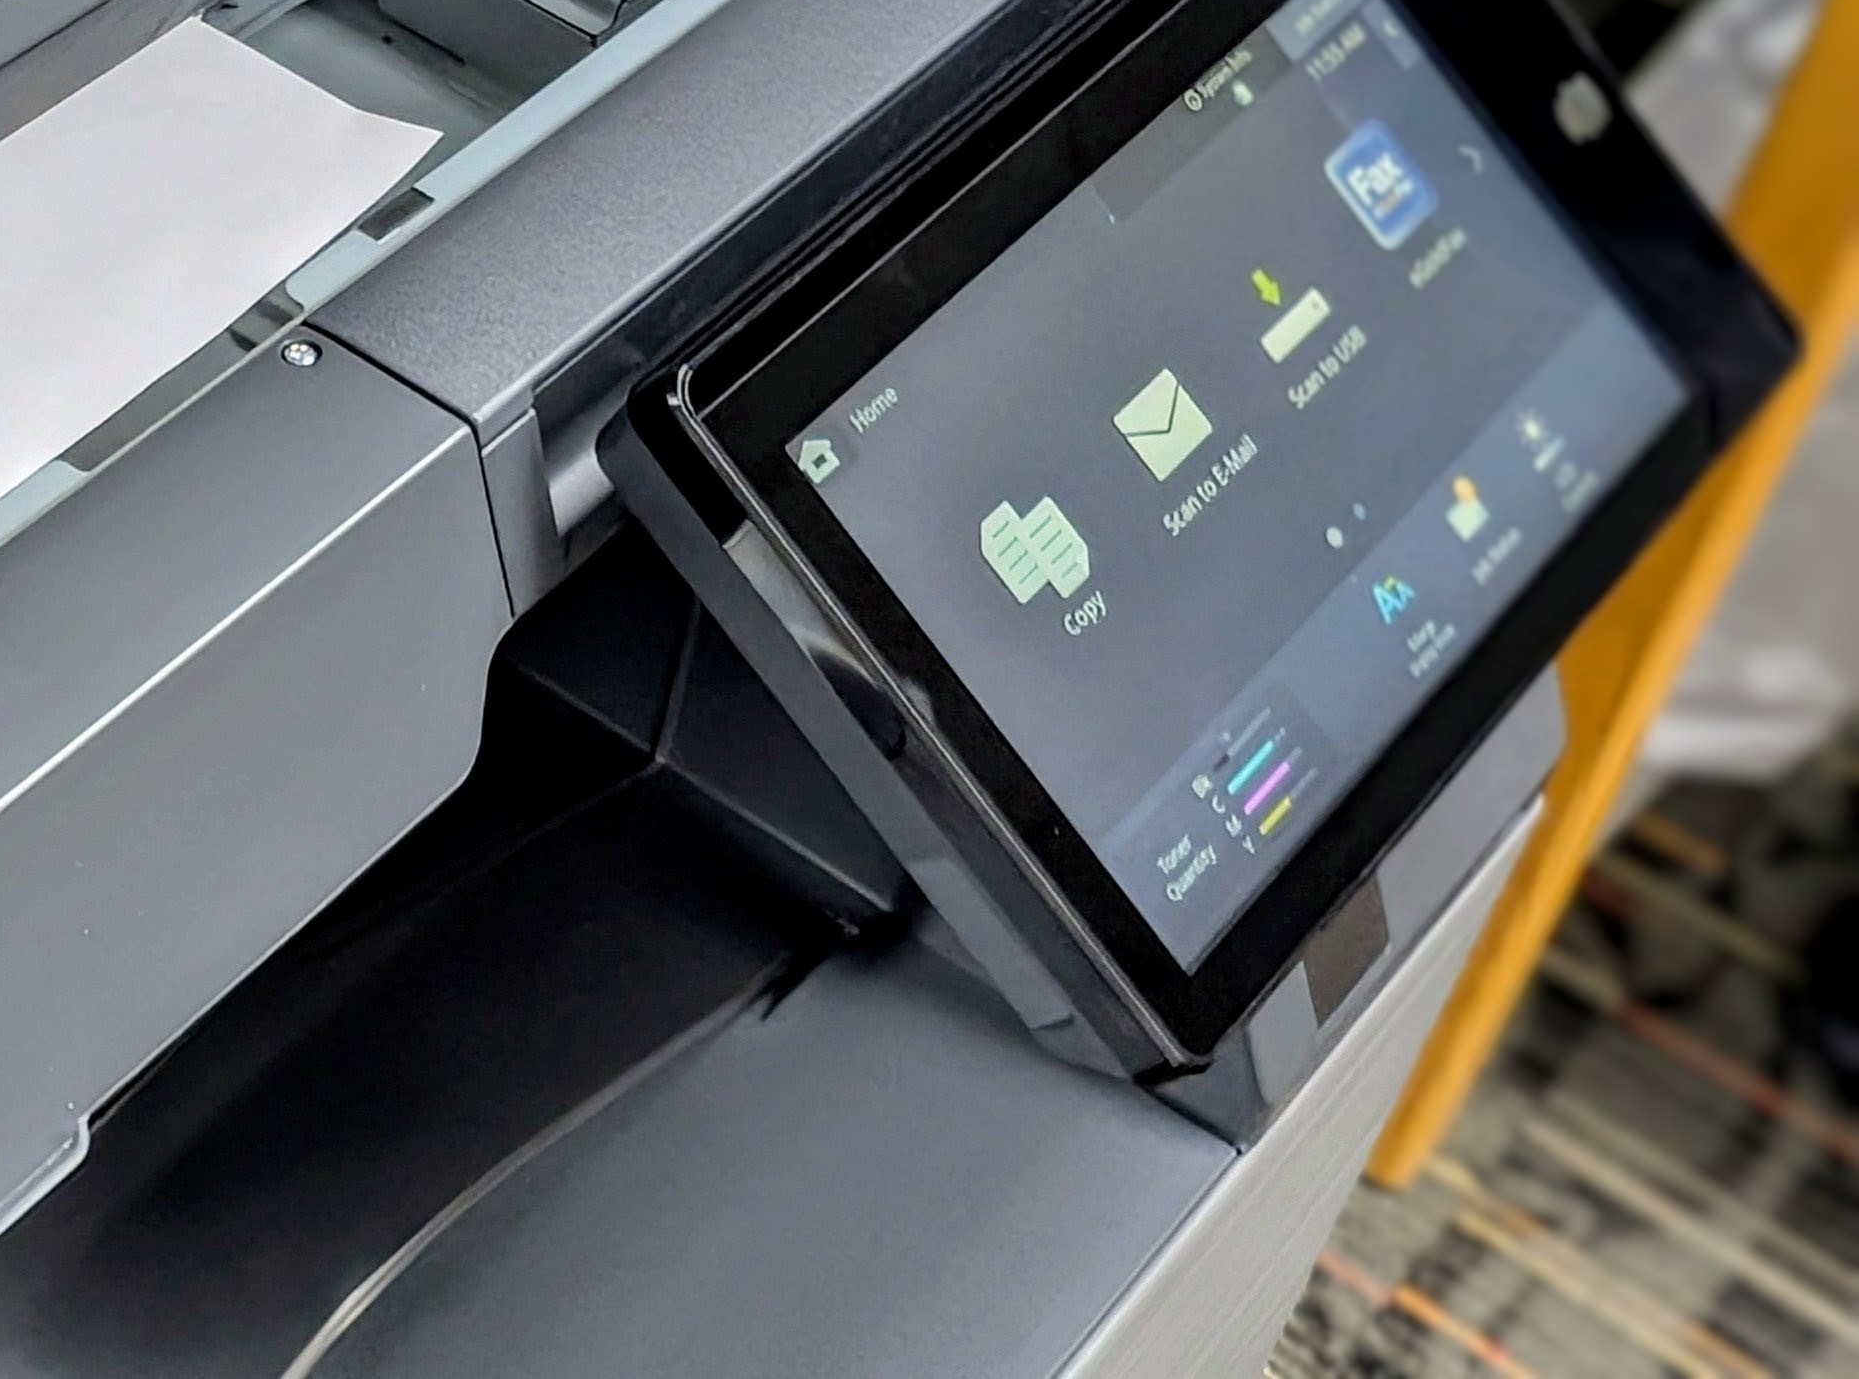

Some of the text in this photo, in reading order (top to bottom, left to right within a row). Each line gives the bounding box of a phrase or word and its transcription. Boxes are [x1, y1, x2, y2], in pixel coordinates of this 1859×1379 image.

[1341, 24, 1366, 48] AM
[1347, 153, 1402, 204] Fax
[1288, 324, 1368, 410] Scan to USB
[848, 385, 899, 434] Home
[1162, 433, 1258, 537] Scan to E-Mail
[1062, 588, 1107, 637] Copy
[1211, 794, 1226, 814] C
[1156, 834, 1191, 875] Toner
[1243, 834, 1257, 856] Y
[1166, 844, 1218, 902] Quantity
